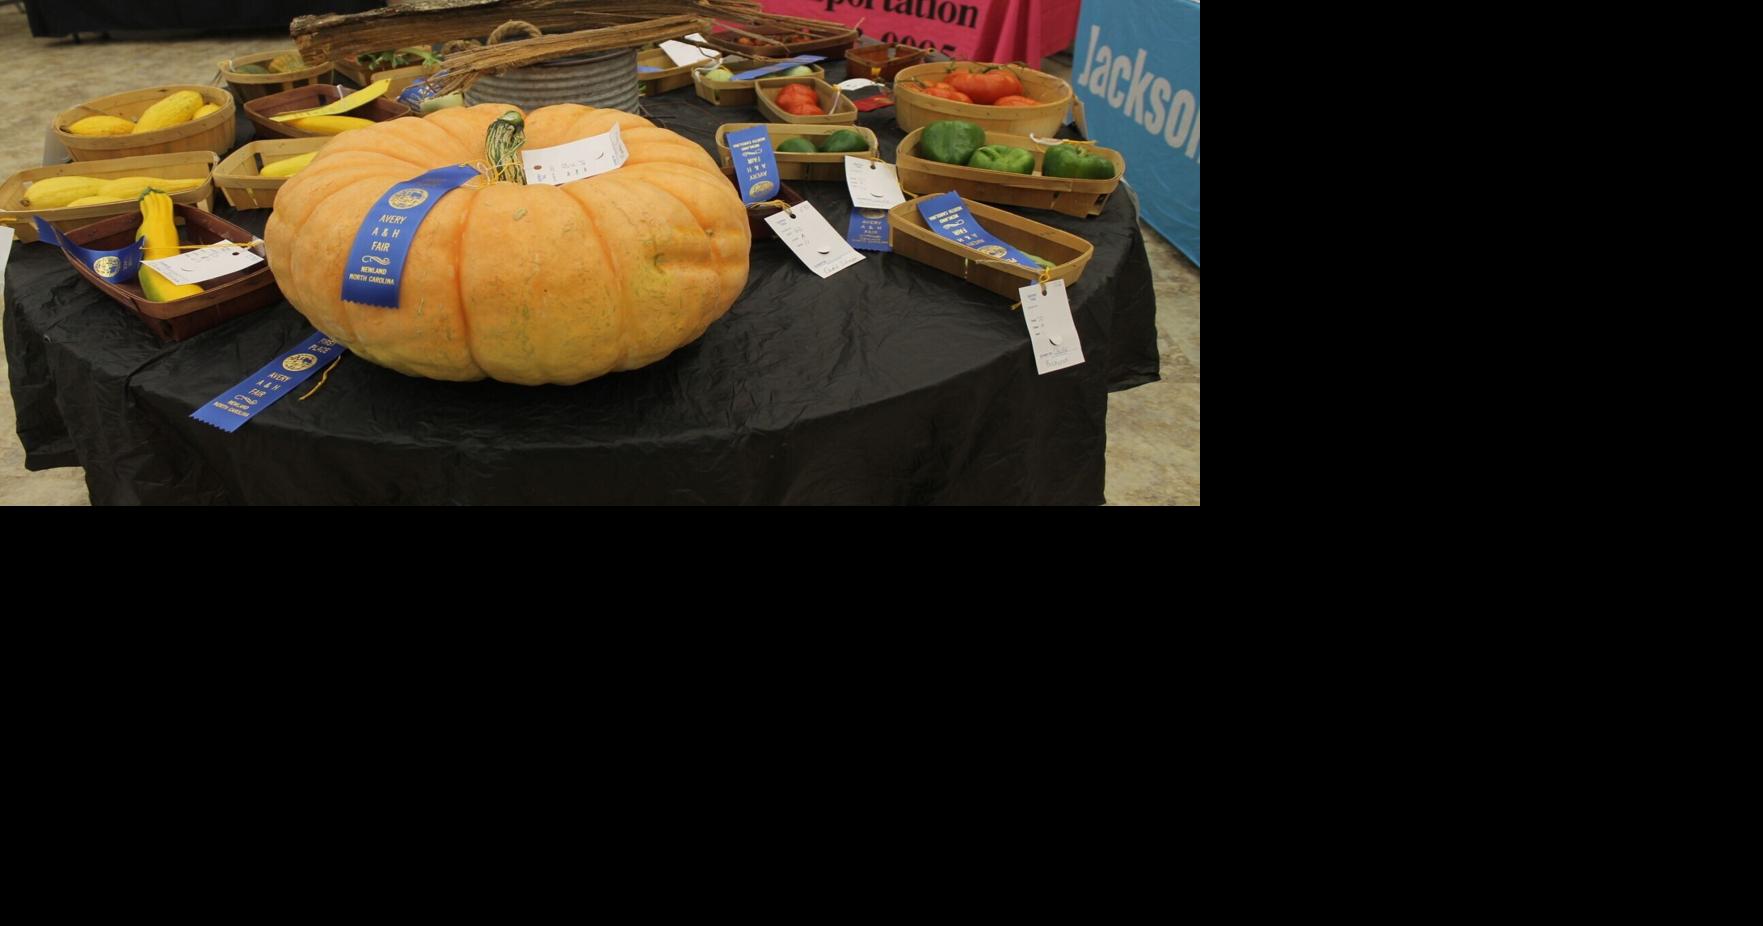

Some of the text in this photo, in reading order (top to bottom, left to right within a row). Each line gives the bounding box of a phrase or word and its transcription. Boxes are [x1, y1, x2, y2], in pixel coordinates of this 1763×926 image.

[379, 214, 406, 224] AVERY
[371, 227, 400, 238] A & H
[371, 241, 391, 252] FAIR
[360, 265, 387, 275] NEWLAND
[349, 273, 395, 285] NORTH CAROLINA
[268, 371, 291, 382] AVERY
[248, 388, 267, 398] FAIR
